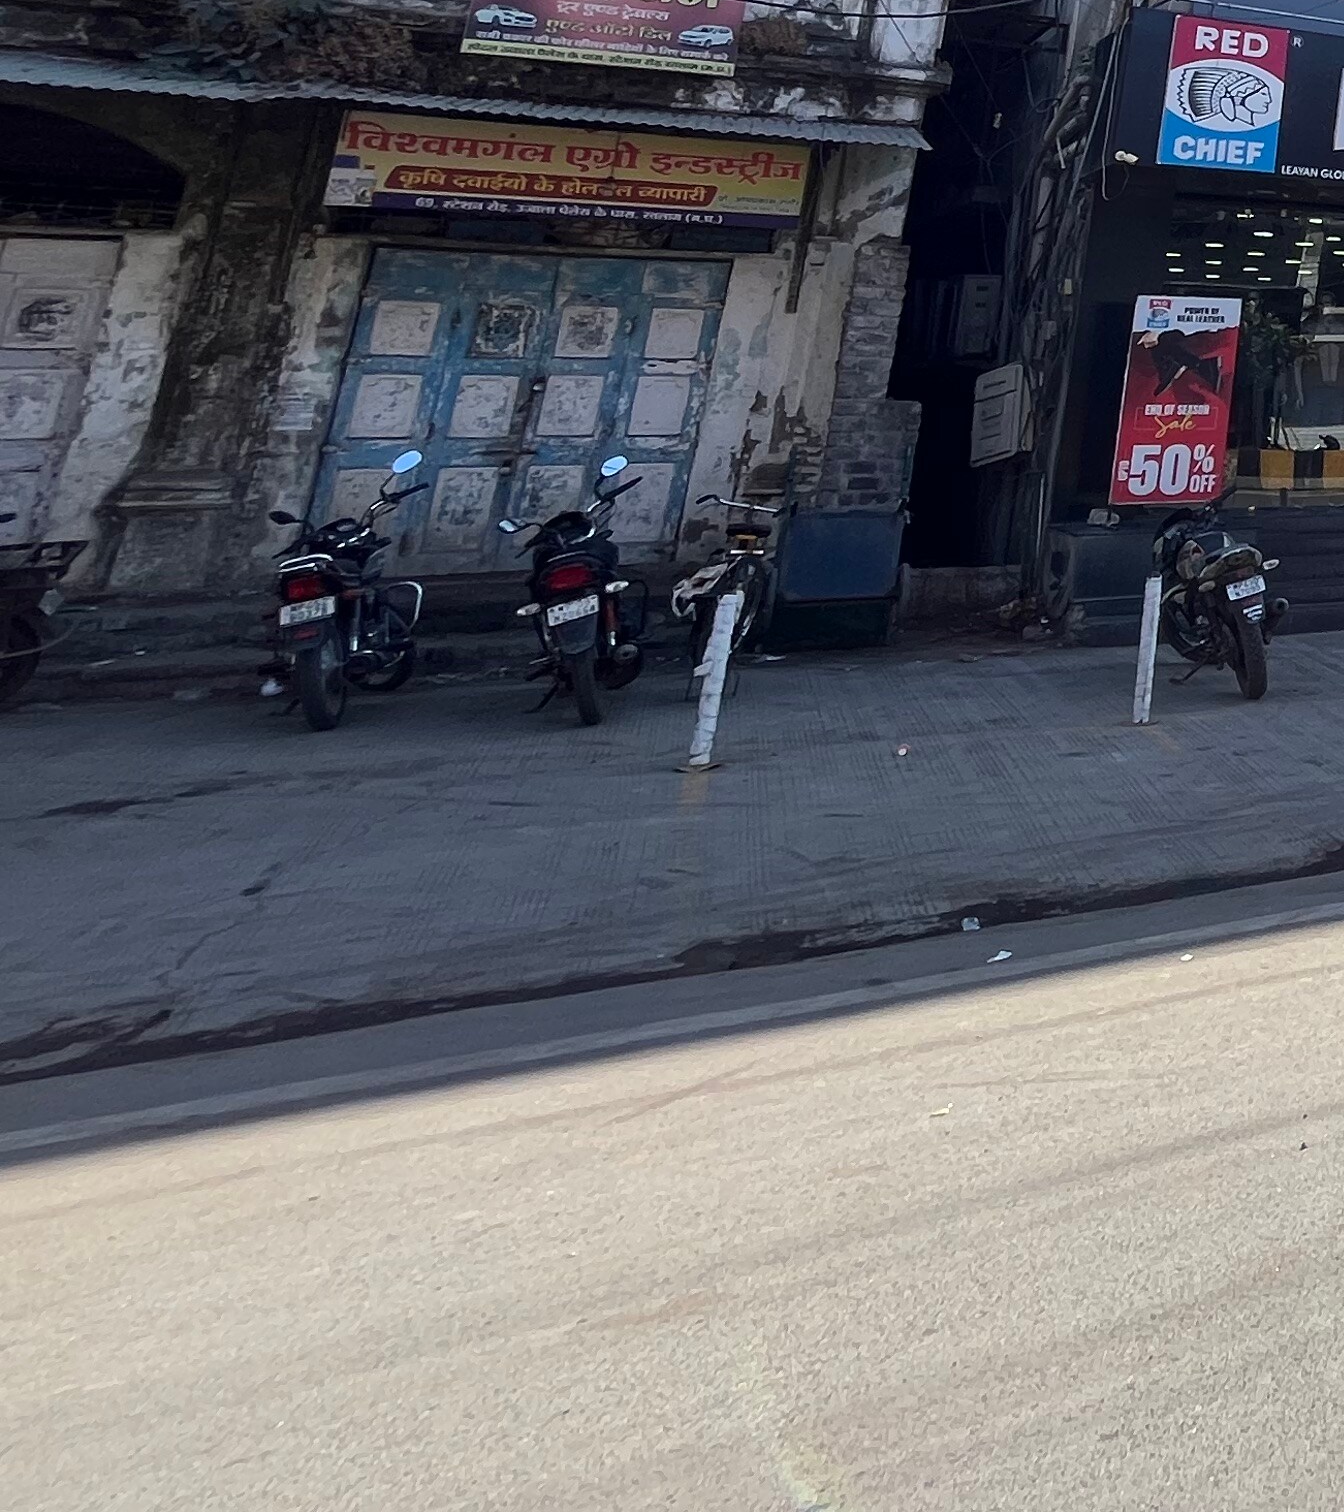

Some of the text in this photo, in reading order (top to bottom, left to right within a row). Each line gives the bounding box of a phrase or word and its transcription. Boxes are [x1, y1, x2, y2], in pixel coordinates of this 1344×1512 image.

[1194, 25, 1269, 58] RED
[1173, 135, 1265, 165] CHIEF
[399, 168, 446, 189] कृषि
[533, 174, 554, 193] के
[638, 185, 708, 202] व्यापारी
[1281, 165, 1319, 178] LEAYAN
[1154, 413, 1197, 438] Sale
[1190, 474, 1216, 494] OFF
